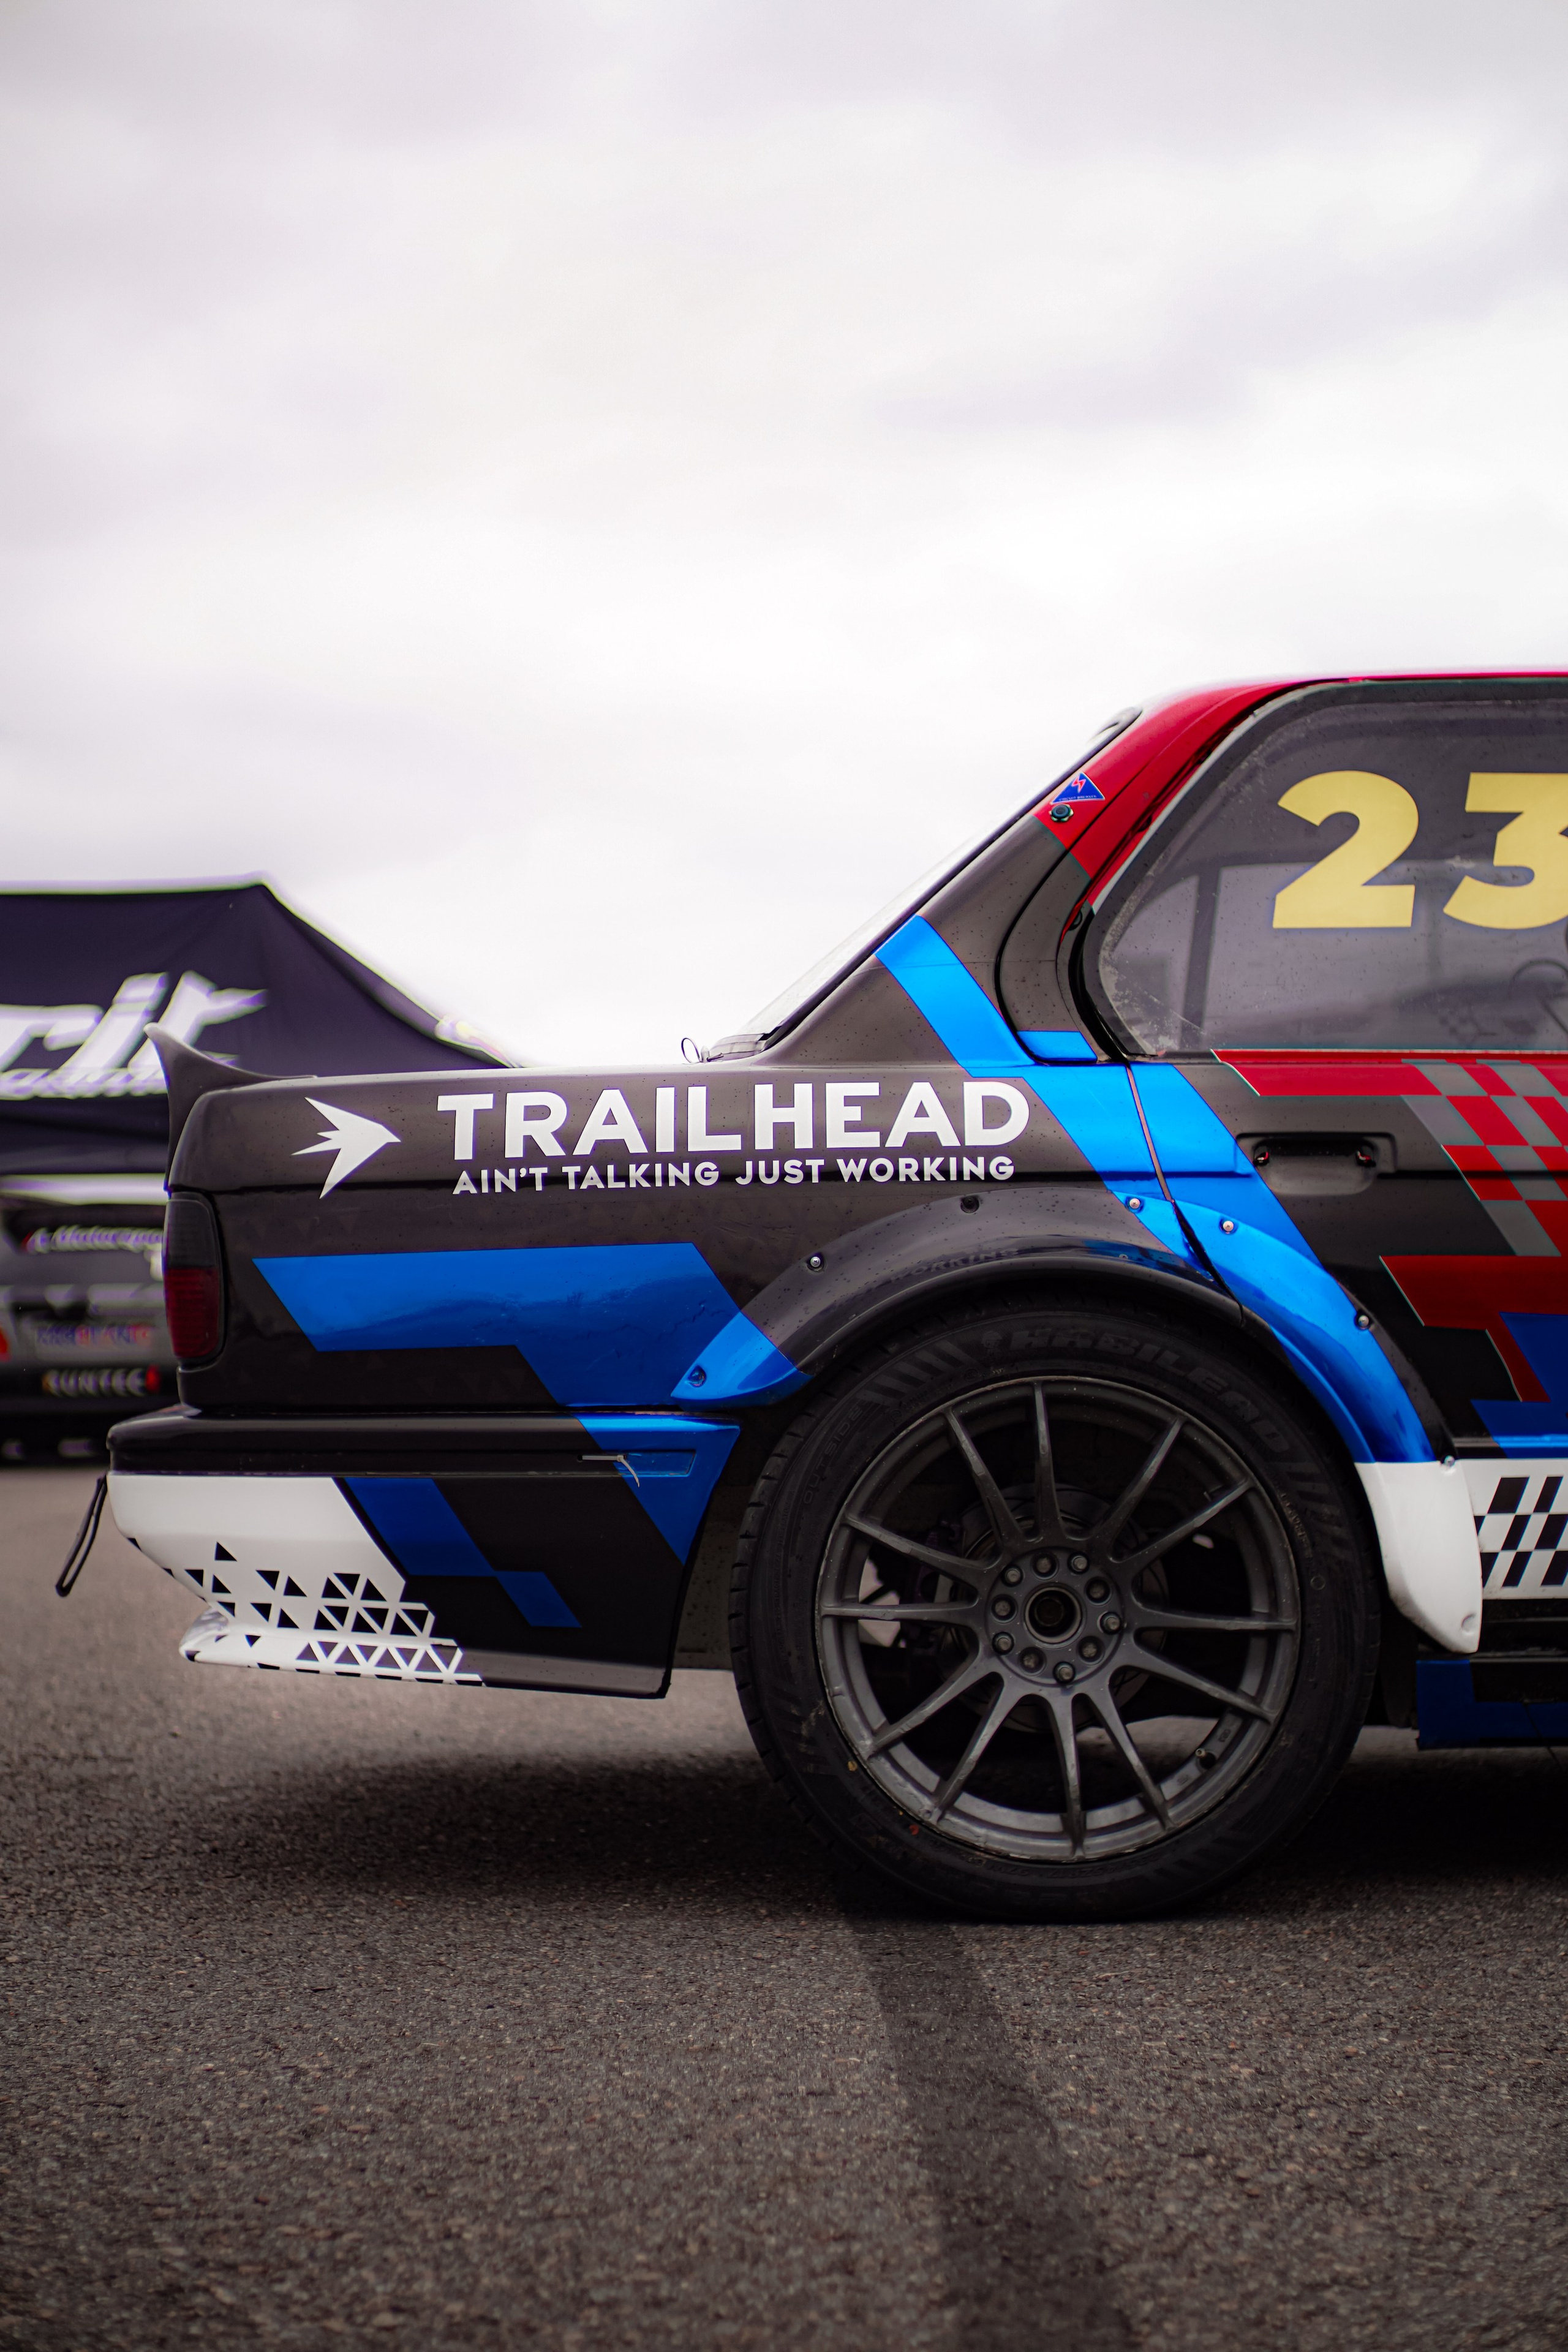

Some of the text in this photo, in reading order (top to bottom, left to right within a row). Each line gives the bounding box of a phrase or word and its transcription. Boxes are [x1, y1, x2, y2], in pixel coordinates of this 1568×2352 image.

[1273, 772, 1568, 929] 23
[437, 1079, 1030, 1159] TRAILHEAD
[453, 1156, 1014, 1193] AIN'T TALKING JUST WORKING
